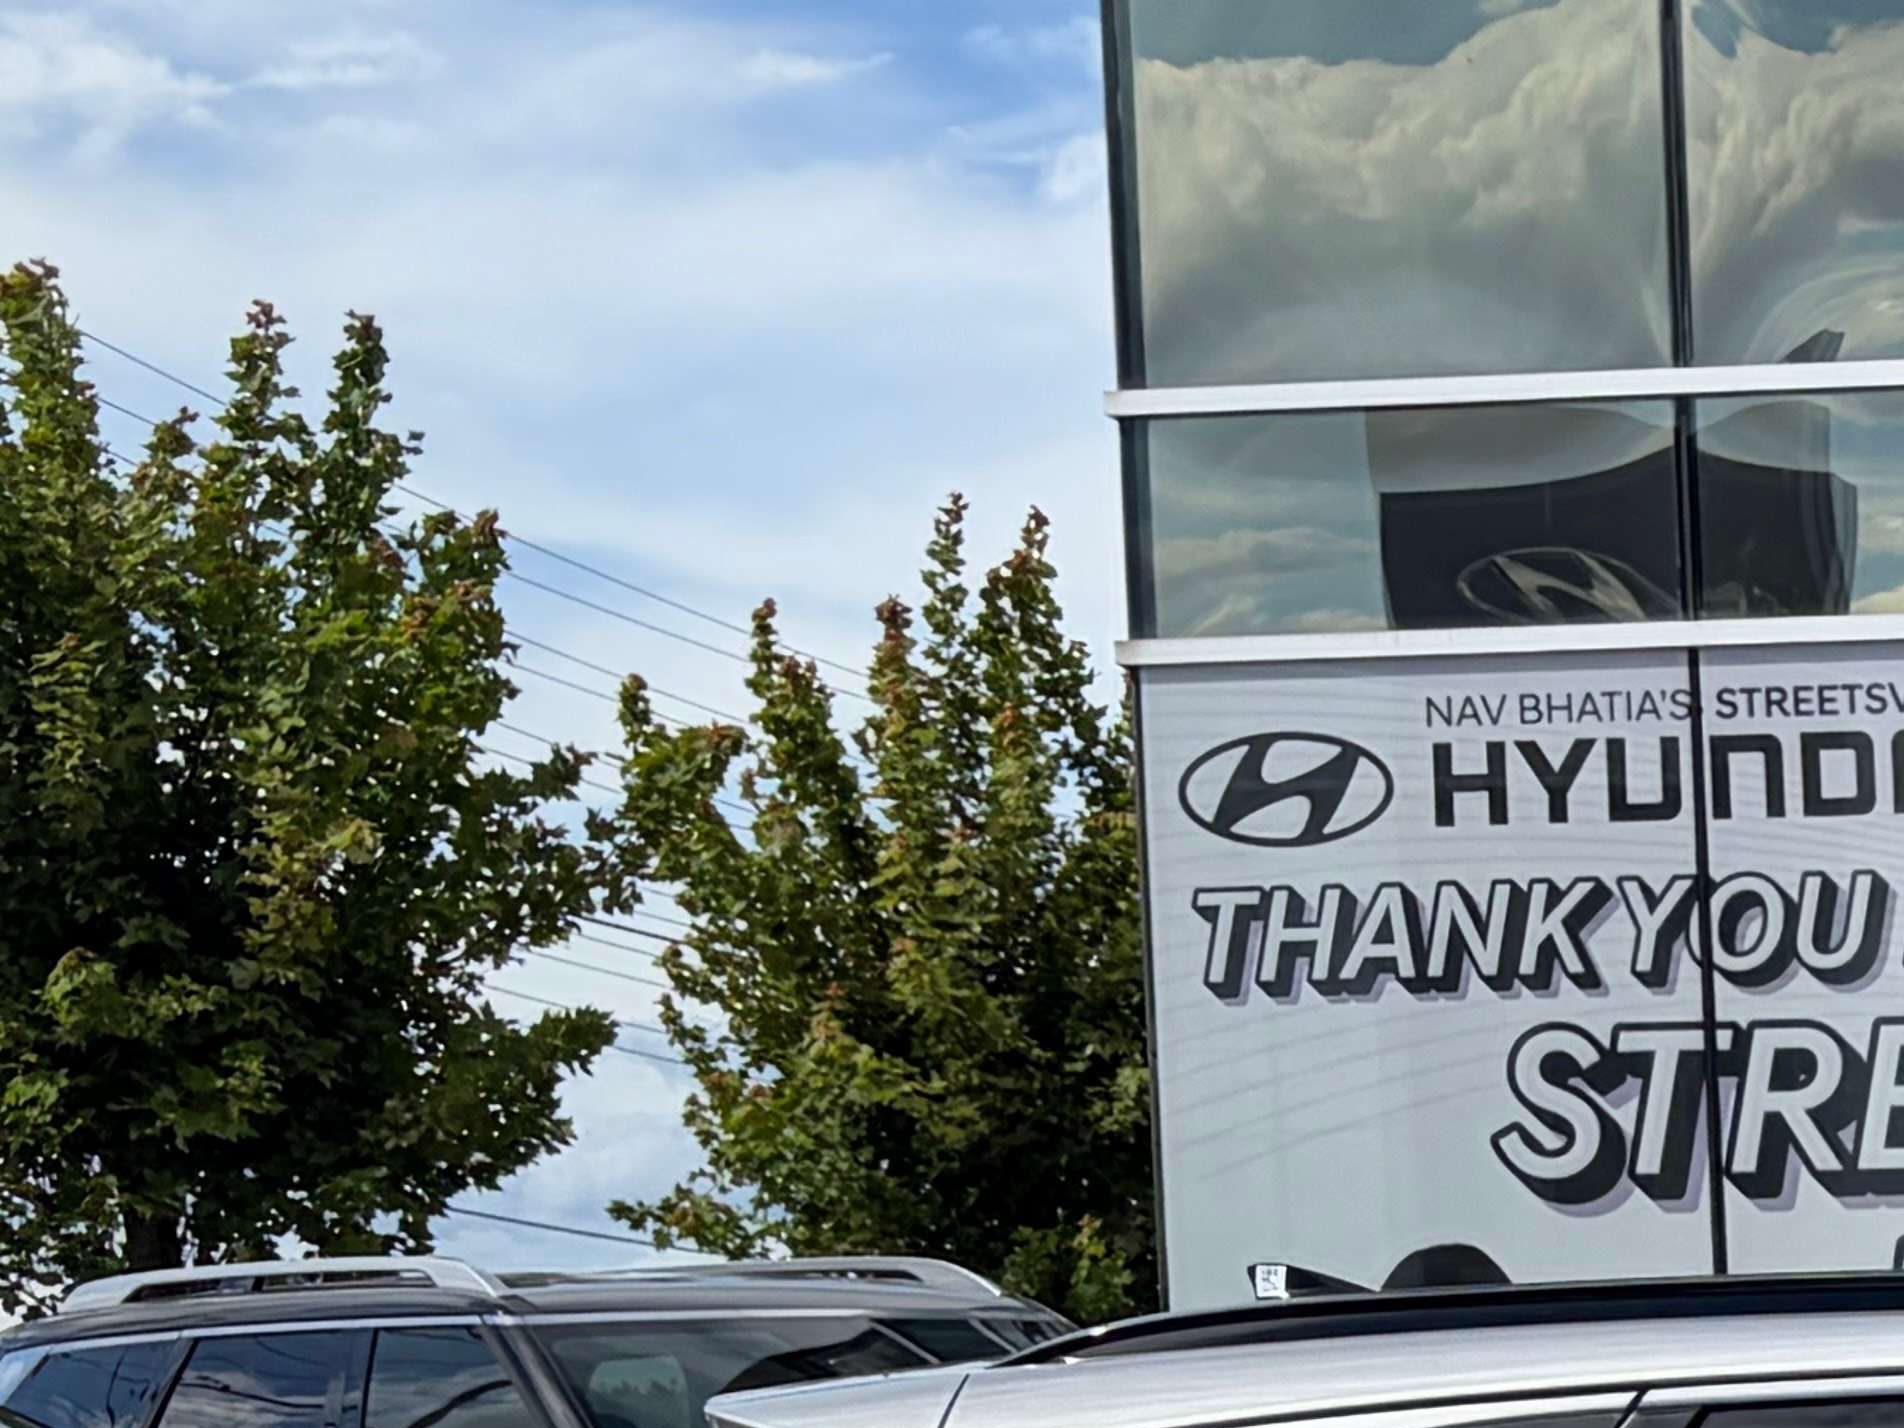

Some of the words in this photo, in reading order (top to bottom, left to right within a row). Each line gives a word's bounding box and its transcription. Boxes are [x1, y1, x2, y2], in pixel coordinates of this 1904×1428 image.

[1425, 692, 1507, 728] NAV
[1518, 688, 1703, 725] BHATIA'S
[1193, 877, 1612, 1003] THANK
[1618, 869, 1896, 995] YOU
